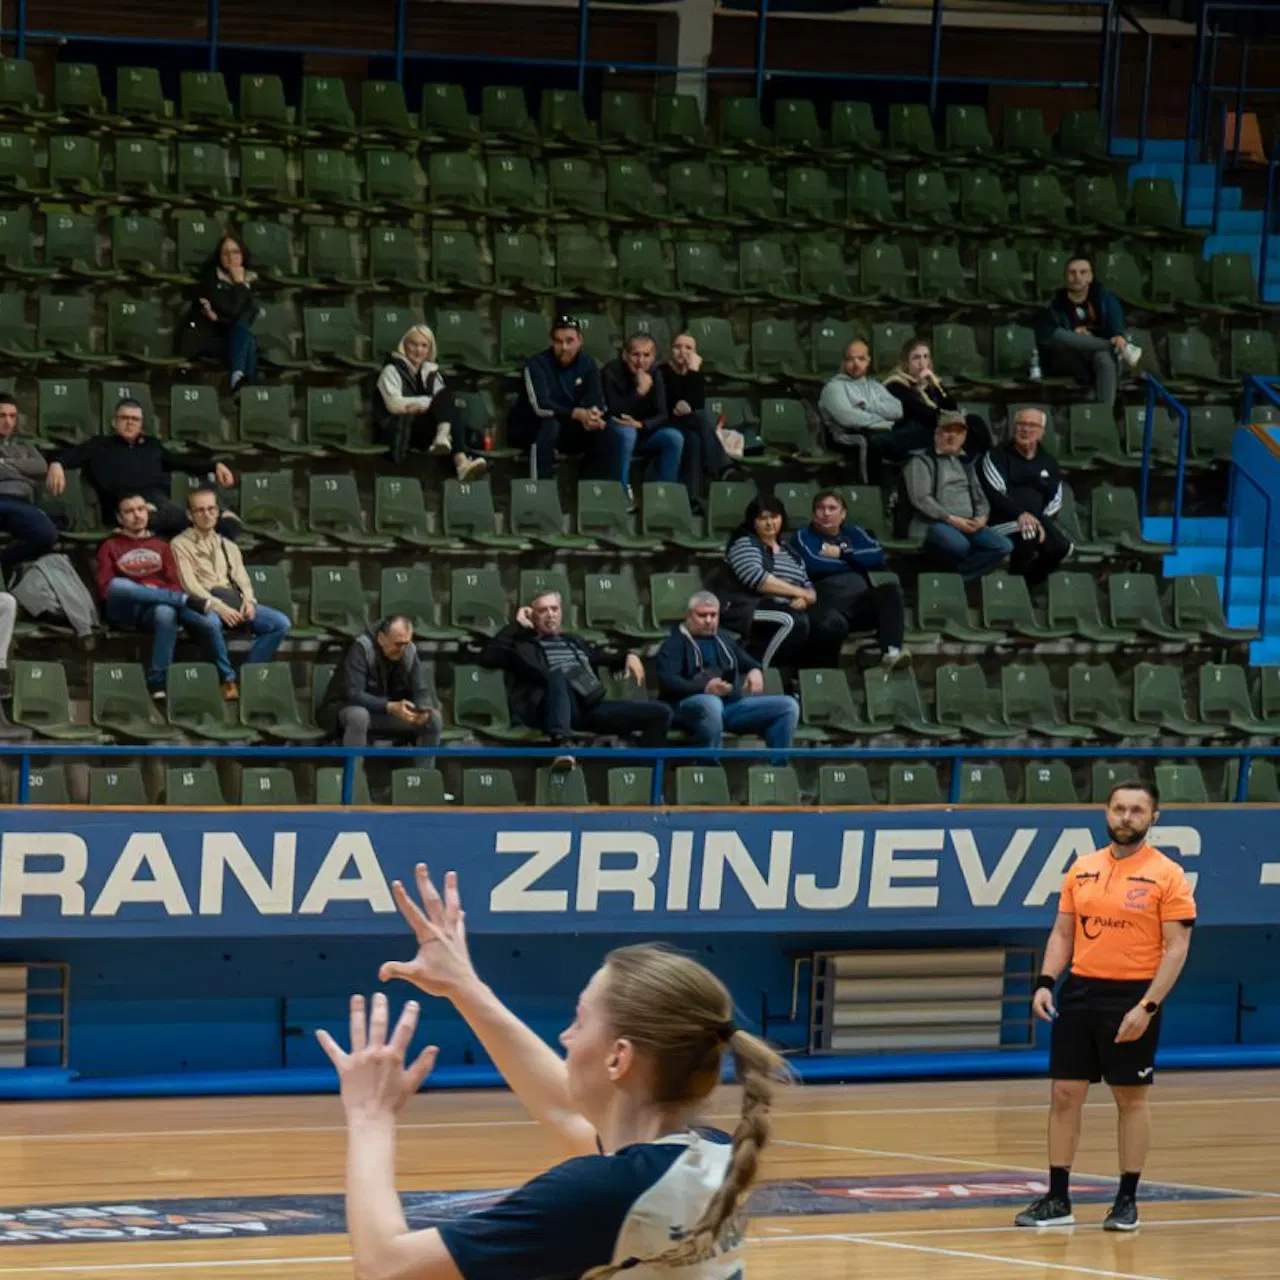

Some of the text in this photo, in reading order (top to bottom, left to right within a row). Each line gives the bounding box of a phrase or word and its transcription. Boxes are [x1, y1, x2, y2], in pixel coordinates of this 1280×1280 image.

[460, 484, 471, 494] 11
[329, 570, 342, 582] 14
[693, 772, 704, 784] 11
